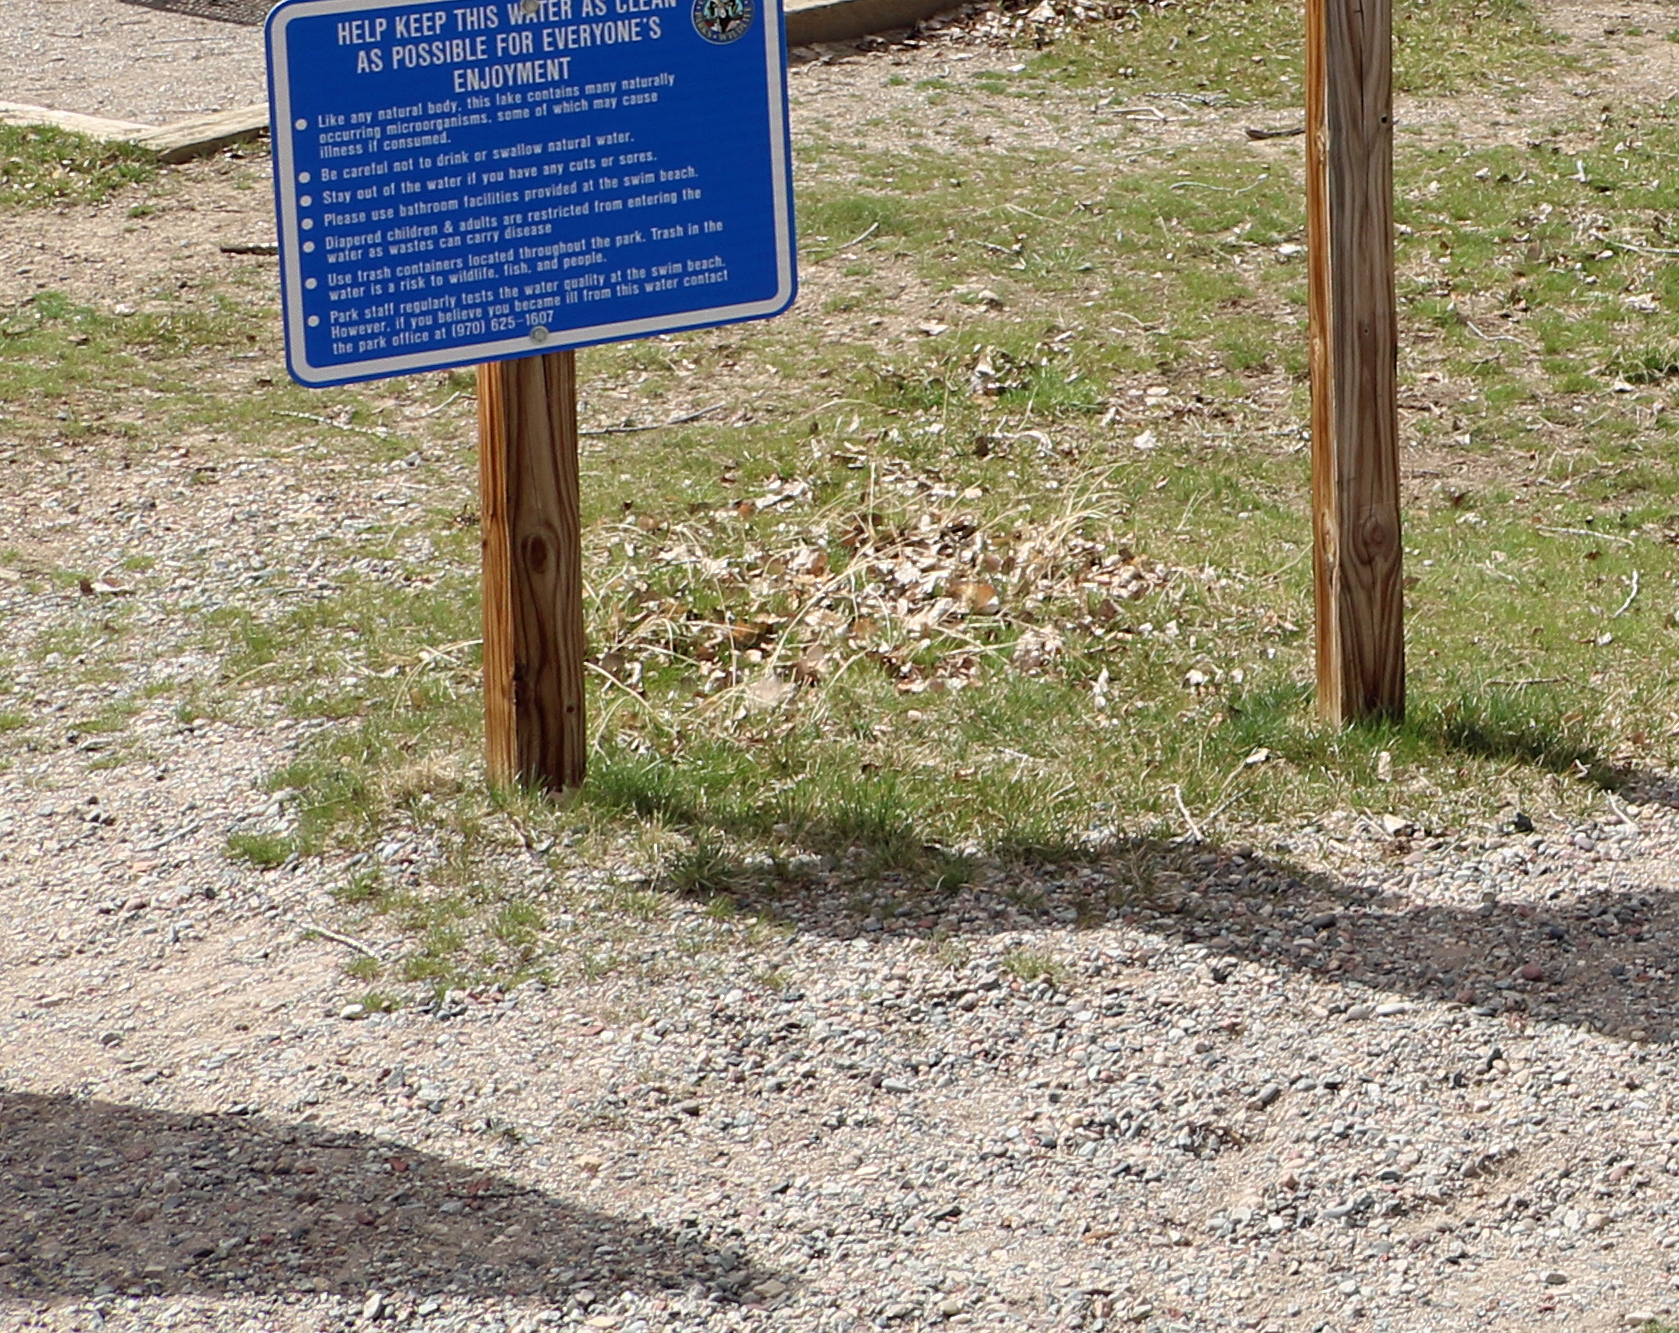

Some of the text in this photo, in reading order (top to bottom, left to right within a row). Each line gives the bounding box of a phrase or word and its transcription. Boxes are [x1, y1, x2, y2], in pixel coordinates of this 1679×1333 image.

[338, 18, 387, 46] HELP
[395, 11, 447, 39] KEEP
[454, 5, 499, 32] THIS
[357, 16, 661, 73] AS POSSIBLE FOR EVERYONE'S
[454, 56, 572, 93] ENJOYMENT
[321, 131, 635, 181] Be careful not to drink or swallow natural water.
[322, 152, 658, 204] Stay out of the water if you have any cuts or sores.
[325, 187, 701, 250] Diapered children & adults are restricted from entering the
[326, 223, 552, 264] water as wastes can carry disease
[330, 255, 727, 324] Park staff regularly tests the water quality at the swim beach.
[333, 310, 554, 355] the park office at (970) 625-1607
